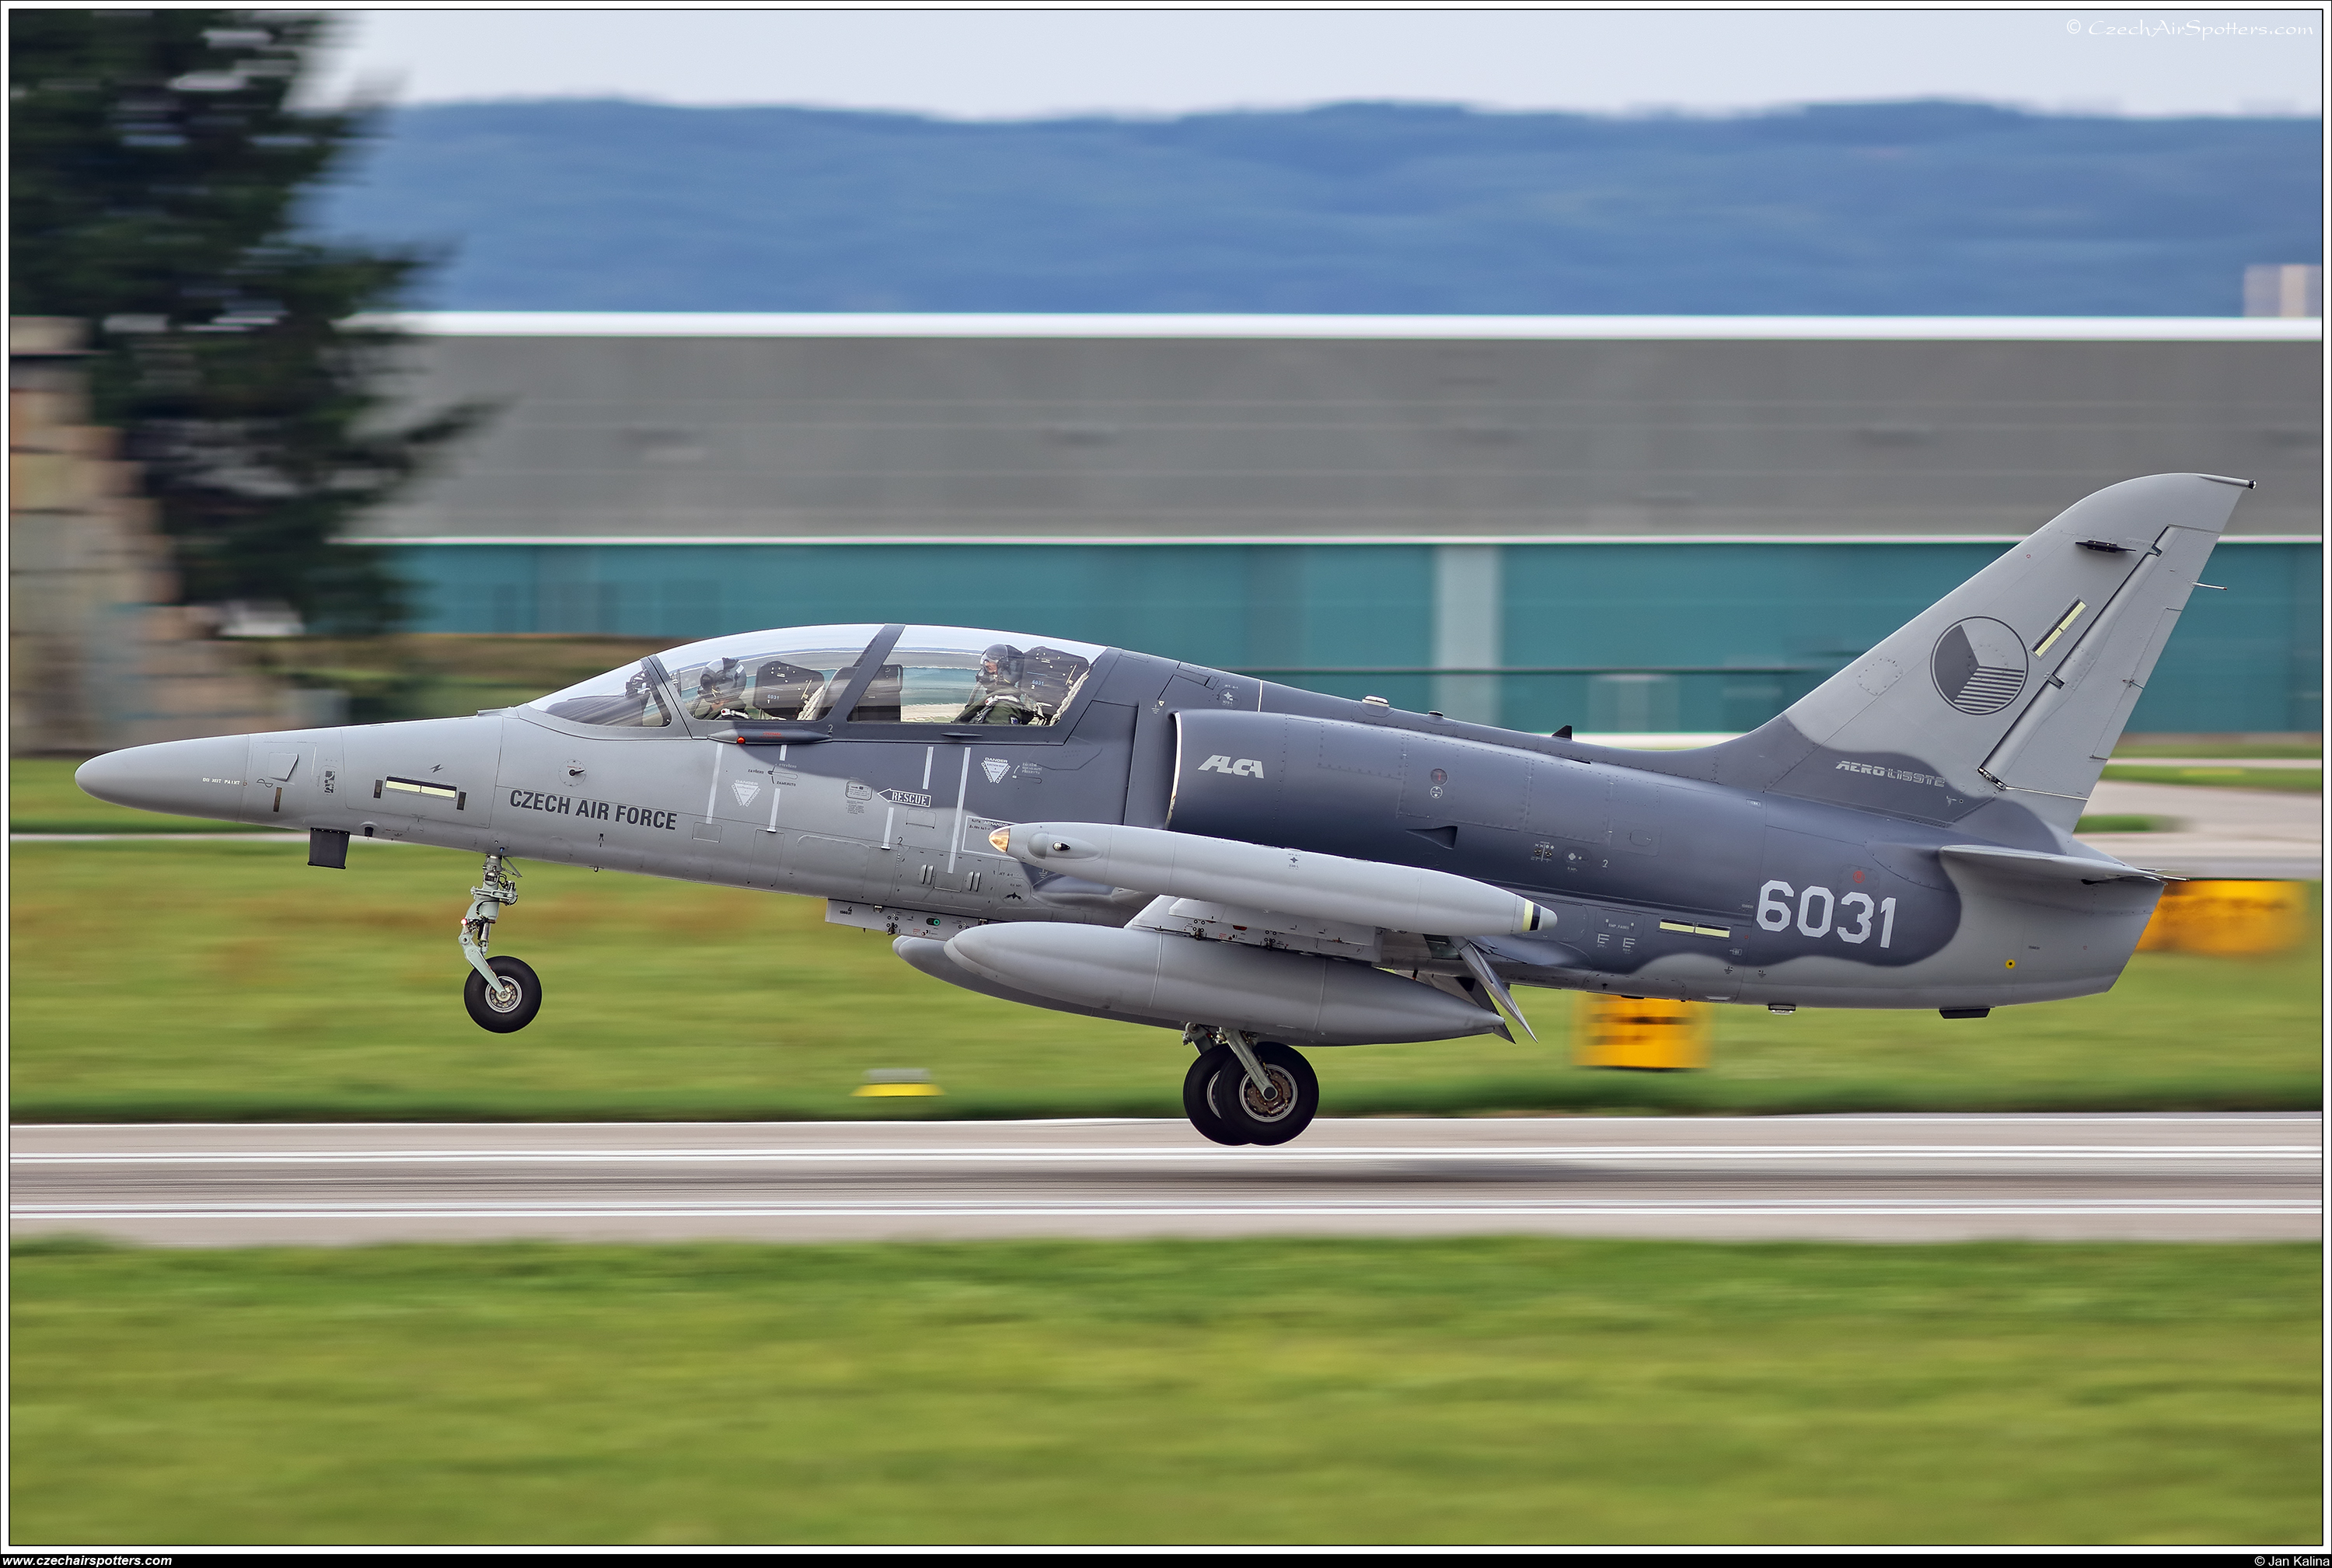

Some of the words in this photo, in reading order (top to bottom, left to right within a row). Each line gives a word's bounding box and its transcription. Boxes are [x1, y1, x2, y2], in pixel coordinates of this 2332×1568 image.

[980, 762, 993, 783] DANGER
[995, 765, 1011, 784] DANGER
[1197, 754, 1265, 779] ALCA
[1835, 760, 1886, 777] AERO
[1887, 768, 1946, 787] L159T2
[731, 784, 742, 806] DANGER
[745, 787, 761, 807] DANGER
[892, 791, 927, 805] RESCUE
[510, 789, 571, 815] CZECH
[575, 799, 609, 821] AIR
[615, 805, 678, 831] FORCE
[1755, 878, 1897, 949] 6031
